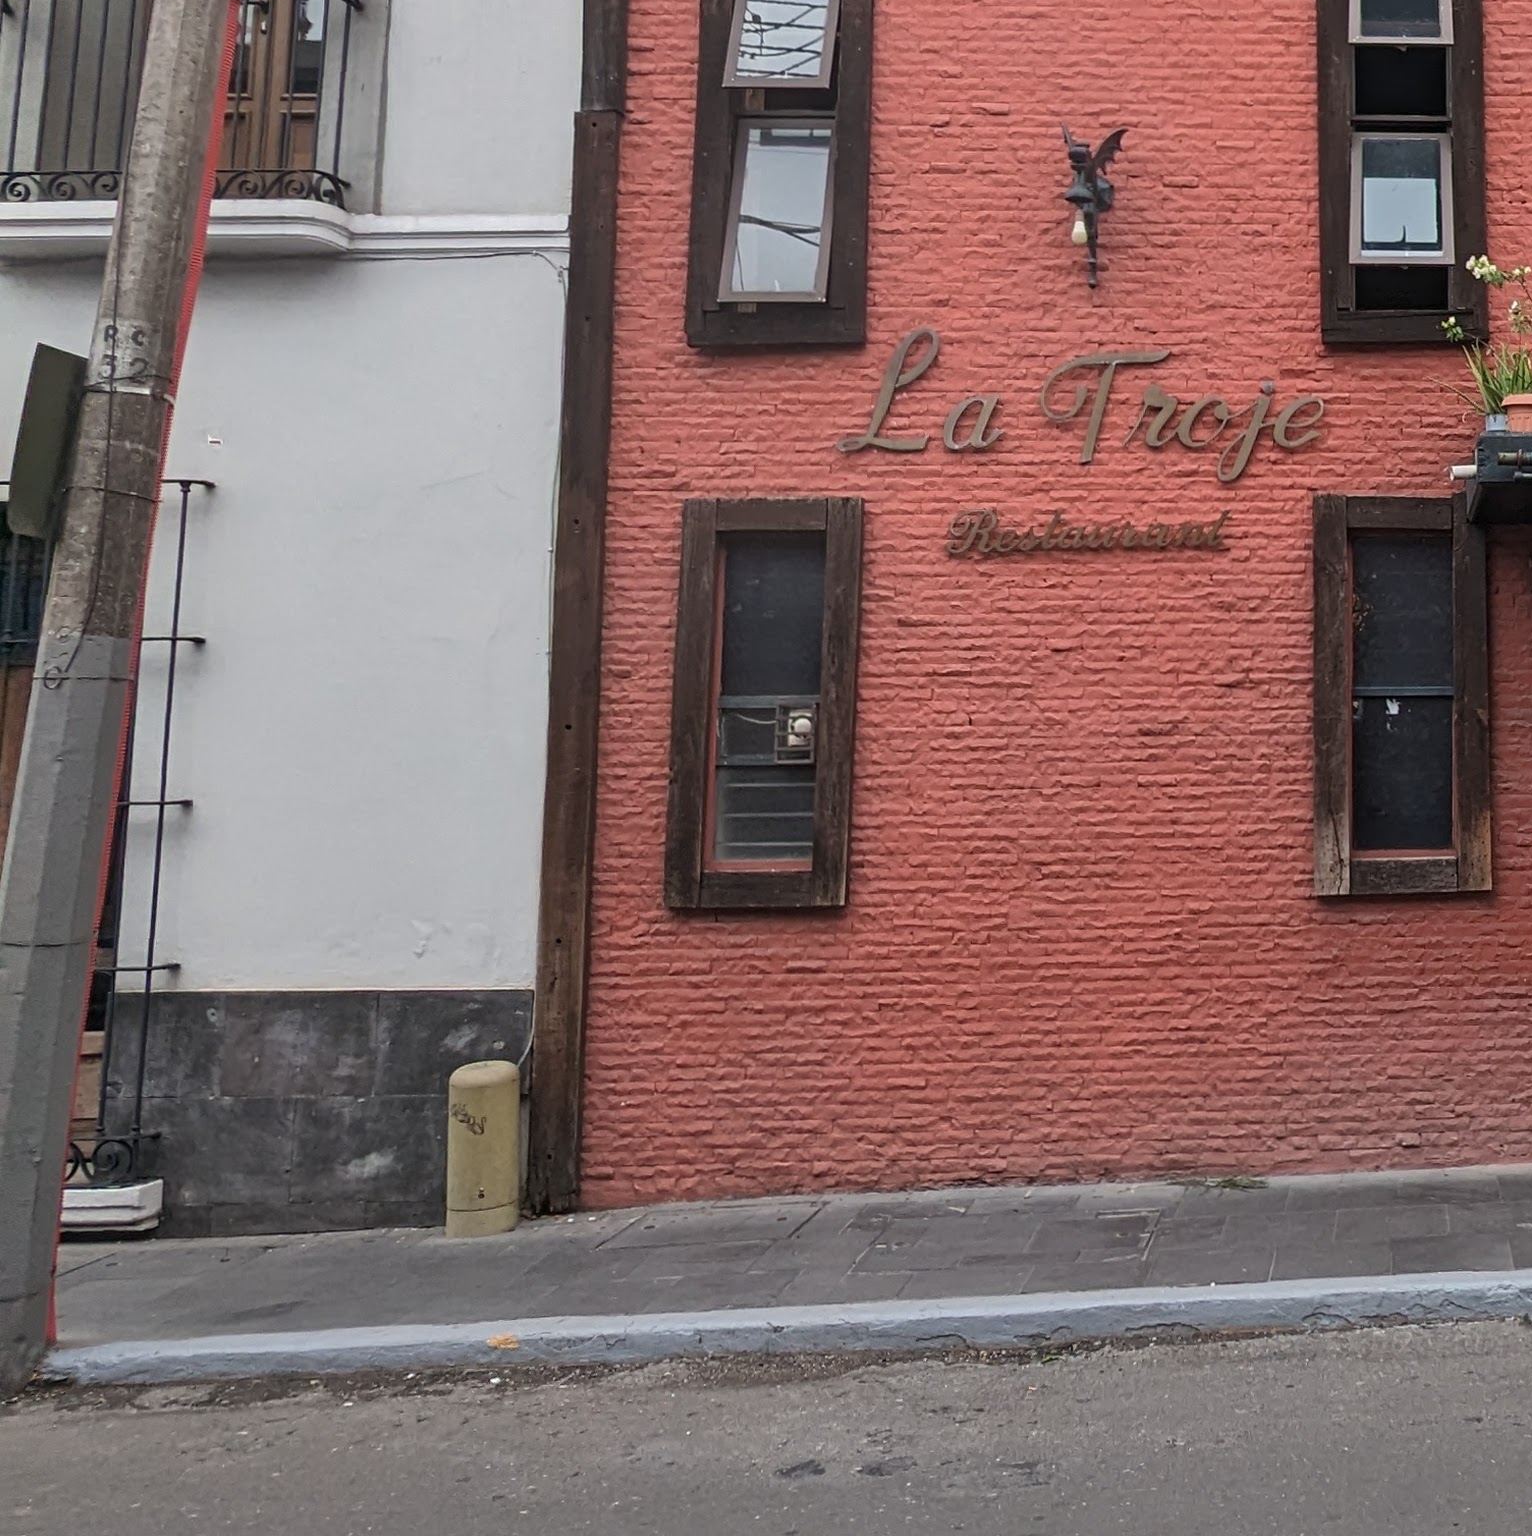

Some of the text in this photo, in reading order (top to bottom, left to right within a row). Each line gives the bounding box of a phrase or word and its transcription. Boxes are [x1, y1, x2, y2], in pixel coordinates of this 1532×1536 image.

[836, 327, 1325, 483] La Troje
[946, 507, 1232, 556] Restaurant
